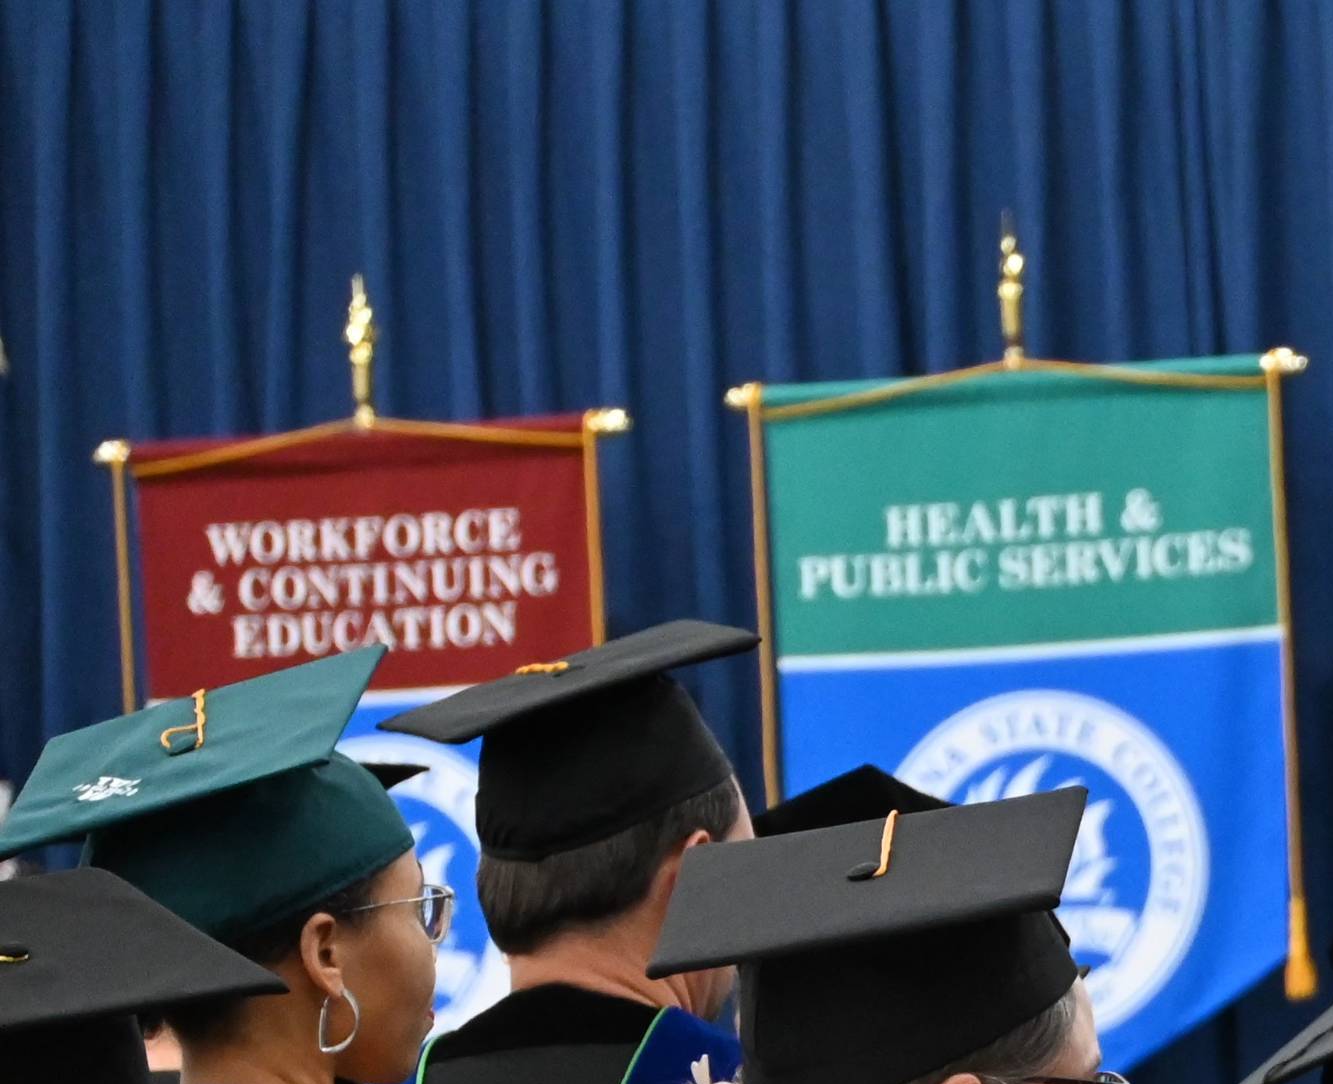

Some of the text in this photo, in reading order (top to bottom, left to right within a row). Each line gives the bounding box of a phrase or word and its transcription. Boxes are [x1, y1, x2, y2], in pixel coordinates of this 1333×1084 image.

[206, 507, 521, 567] WORKFORCE
[885, 487, 1161, 549] HEALTH &
[187, 554, 558, 615] & CONTINUING
[798, 529, 1254, 600] PUBLIC SERVICES
[233, 602, 516, 658] EDUCATION
[976, 708, 1097, 745] STATE
